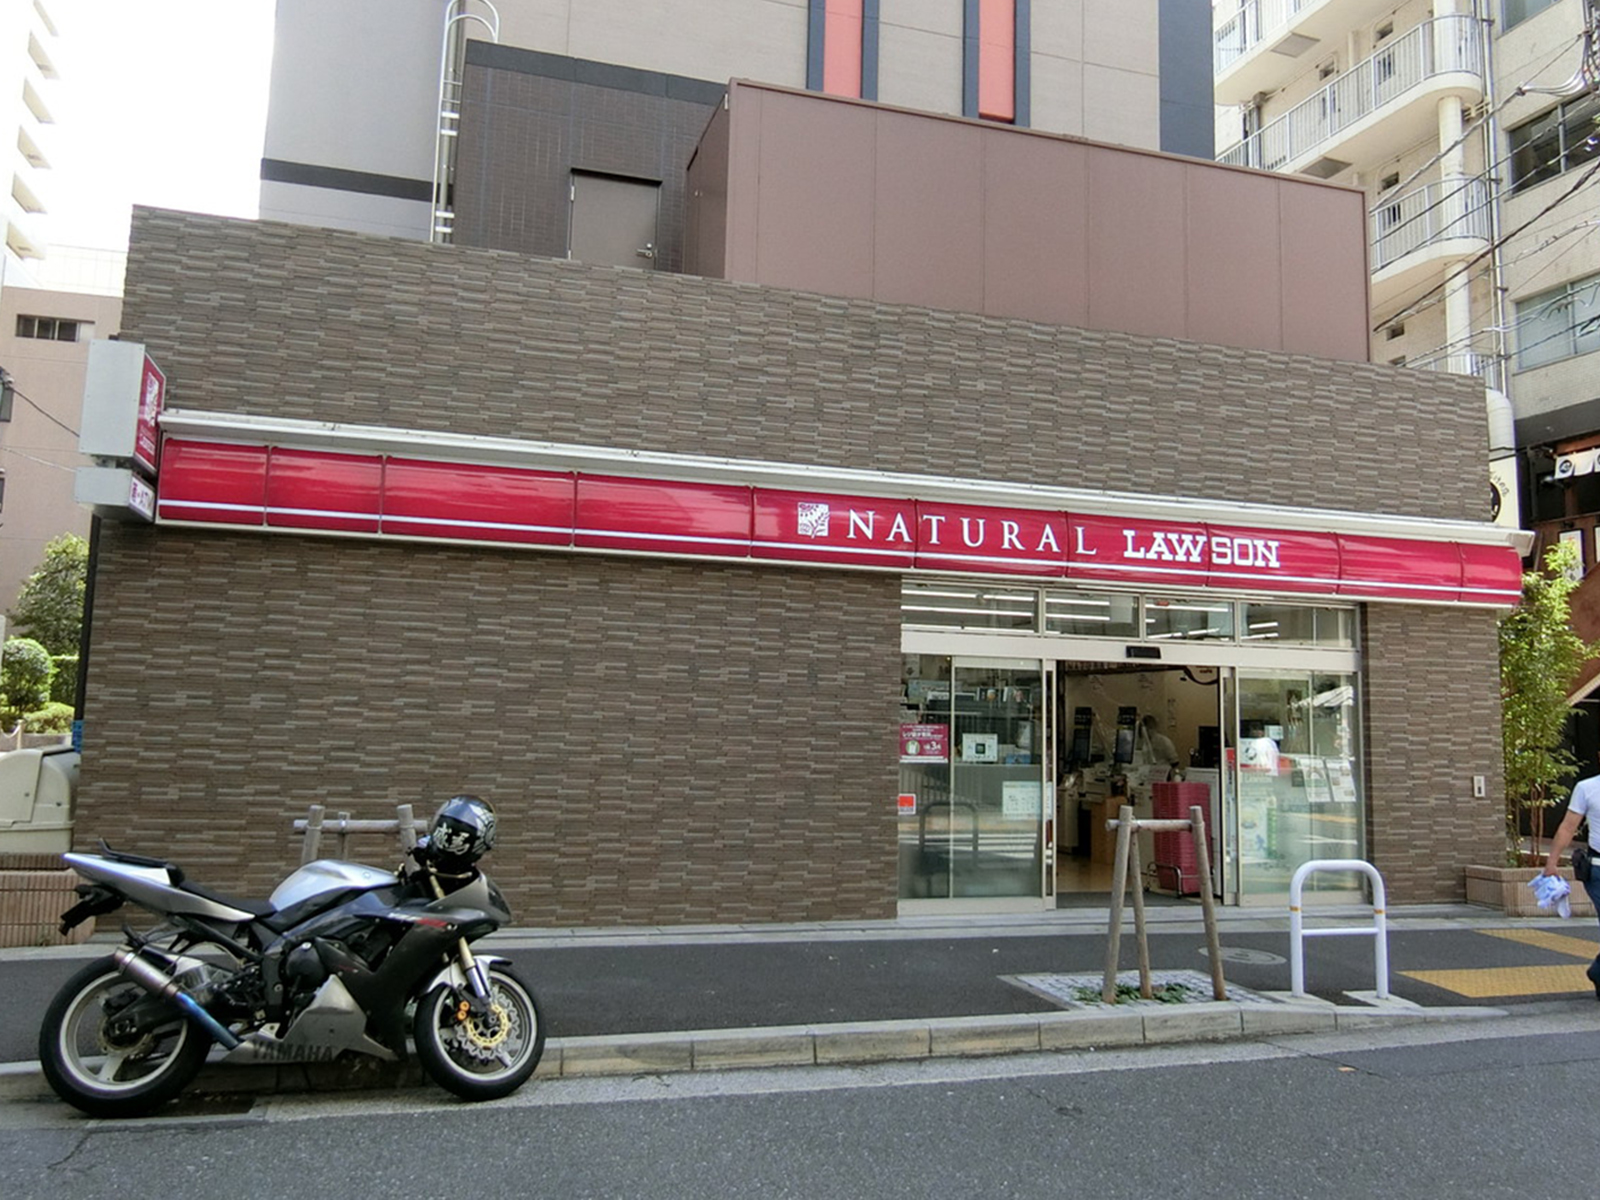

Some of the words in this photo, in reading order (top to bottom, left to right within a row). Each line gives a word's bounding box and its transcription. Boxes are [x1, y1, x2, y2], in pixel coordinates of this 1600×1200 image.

[847, 509, 1097, 556] NATURAL
[1123, 529, 1280, 568] LAWSON
[252, 1039, 334, 1060] YAMAHA
